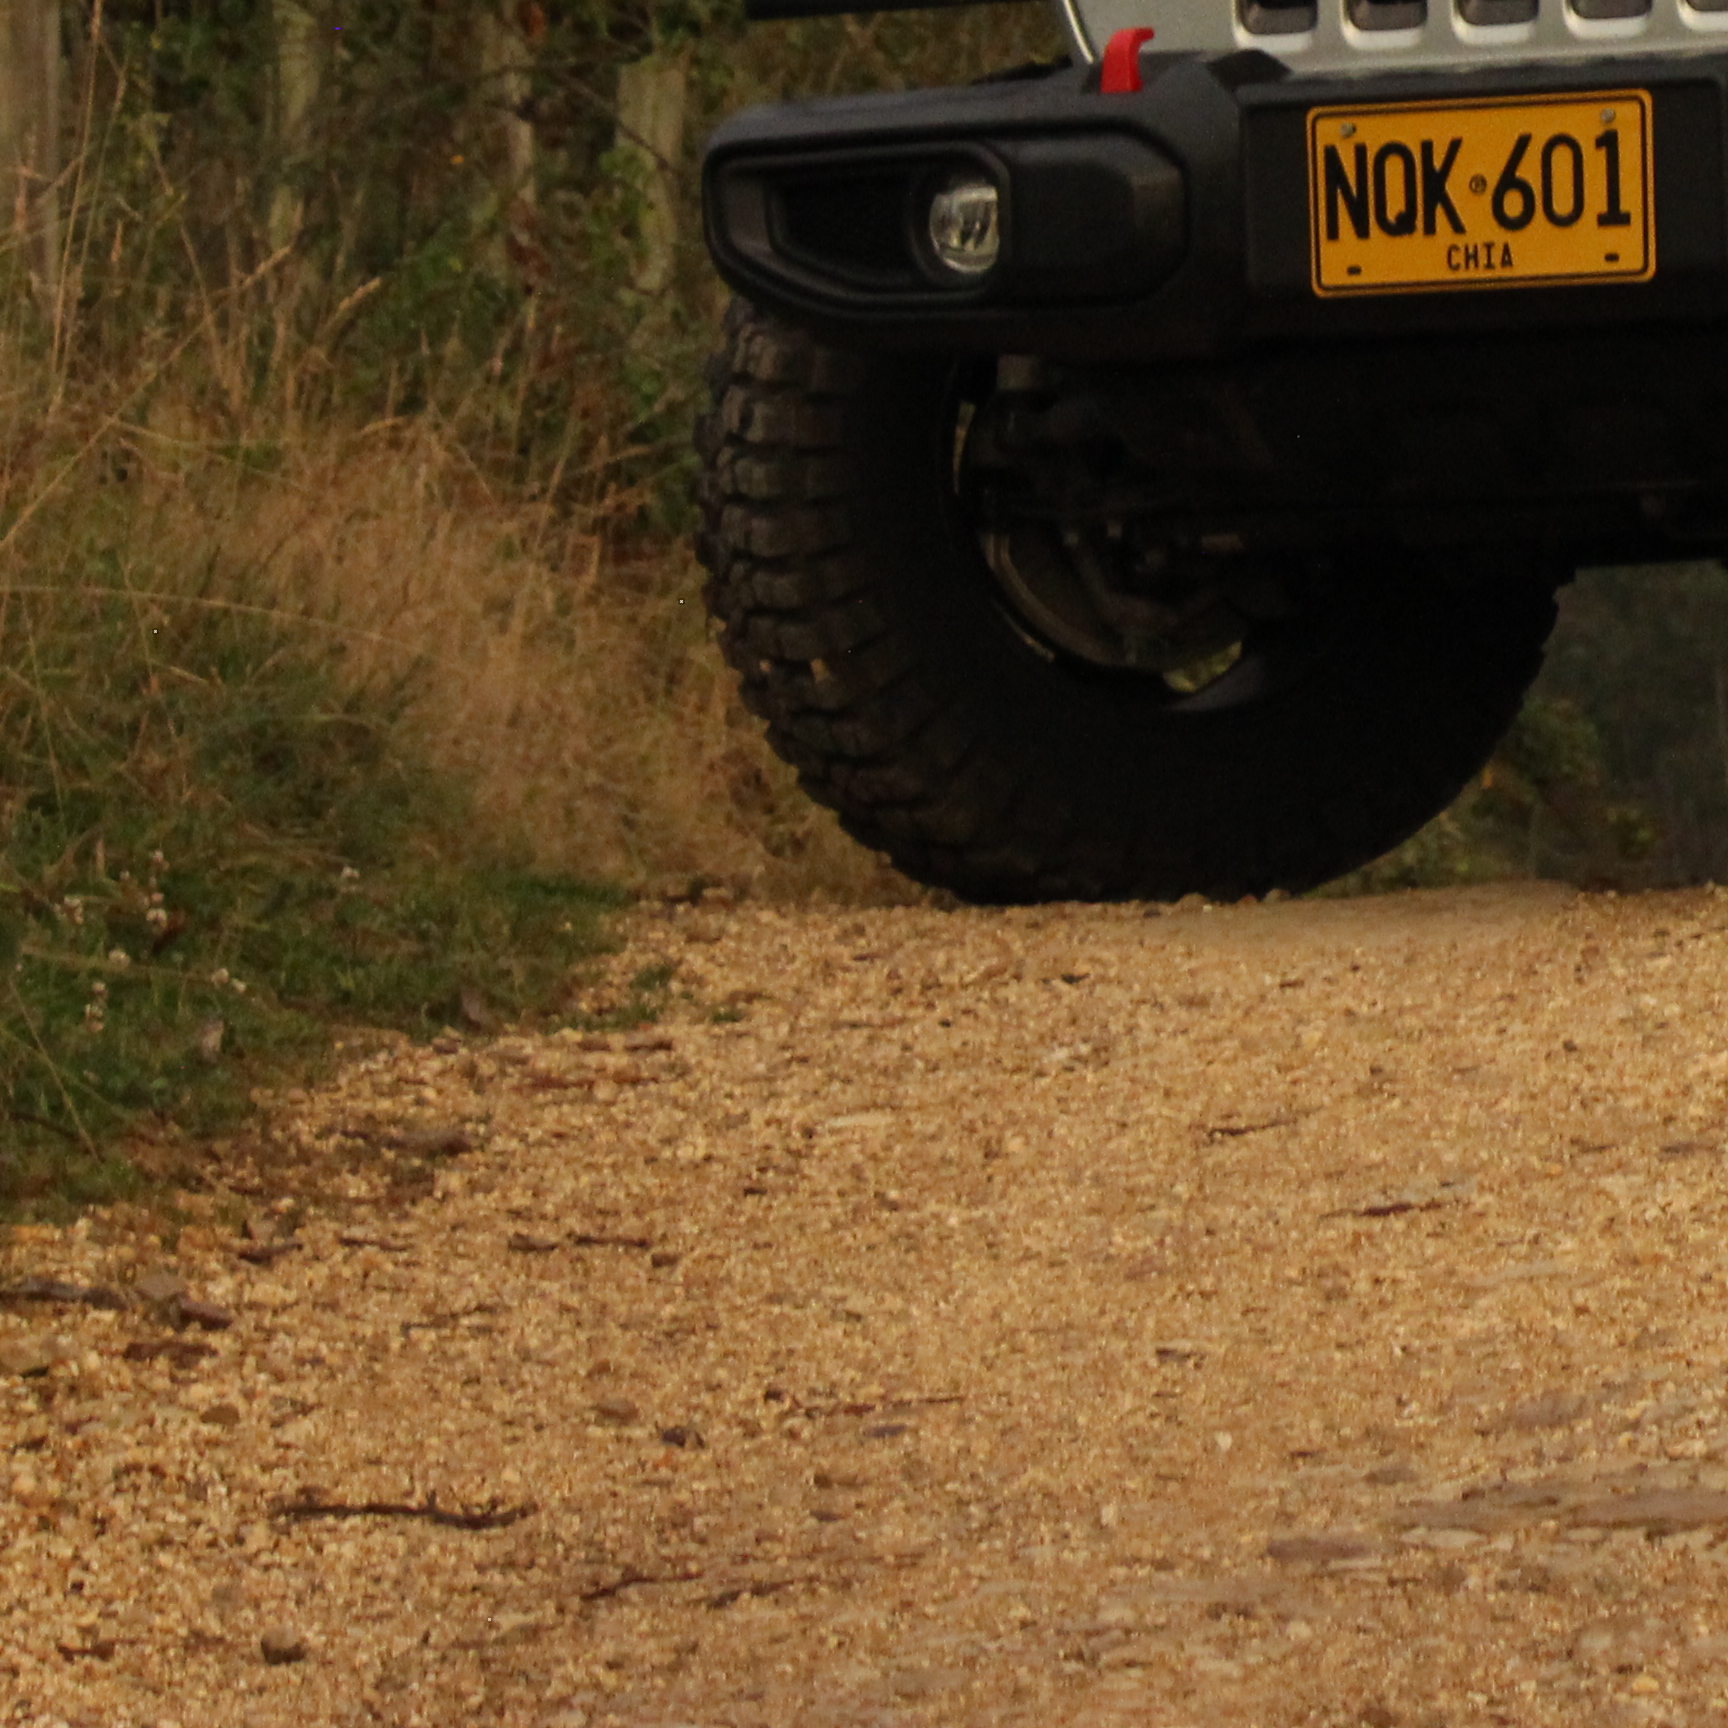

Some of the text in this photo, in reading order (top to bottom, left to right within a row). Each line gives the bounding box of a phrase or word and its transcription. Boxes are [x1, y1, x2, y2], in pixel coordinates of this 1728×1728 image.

[1323, 129, 1631, 241] NQK 601
[1447, 241, 1514, 271] CHIA
